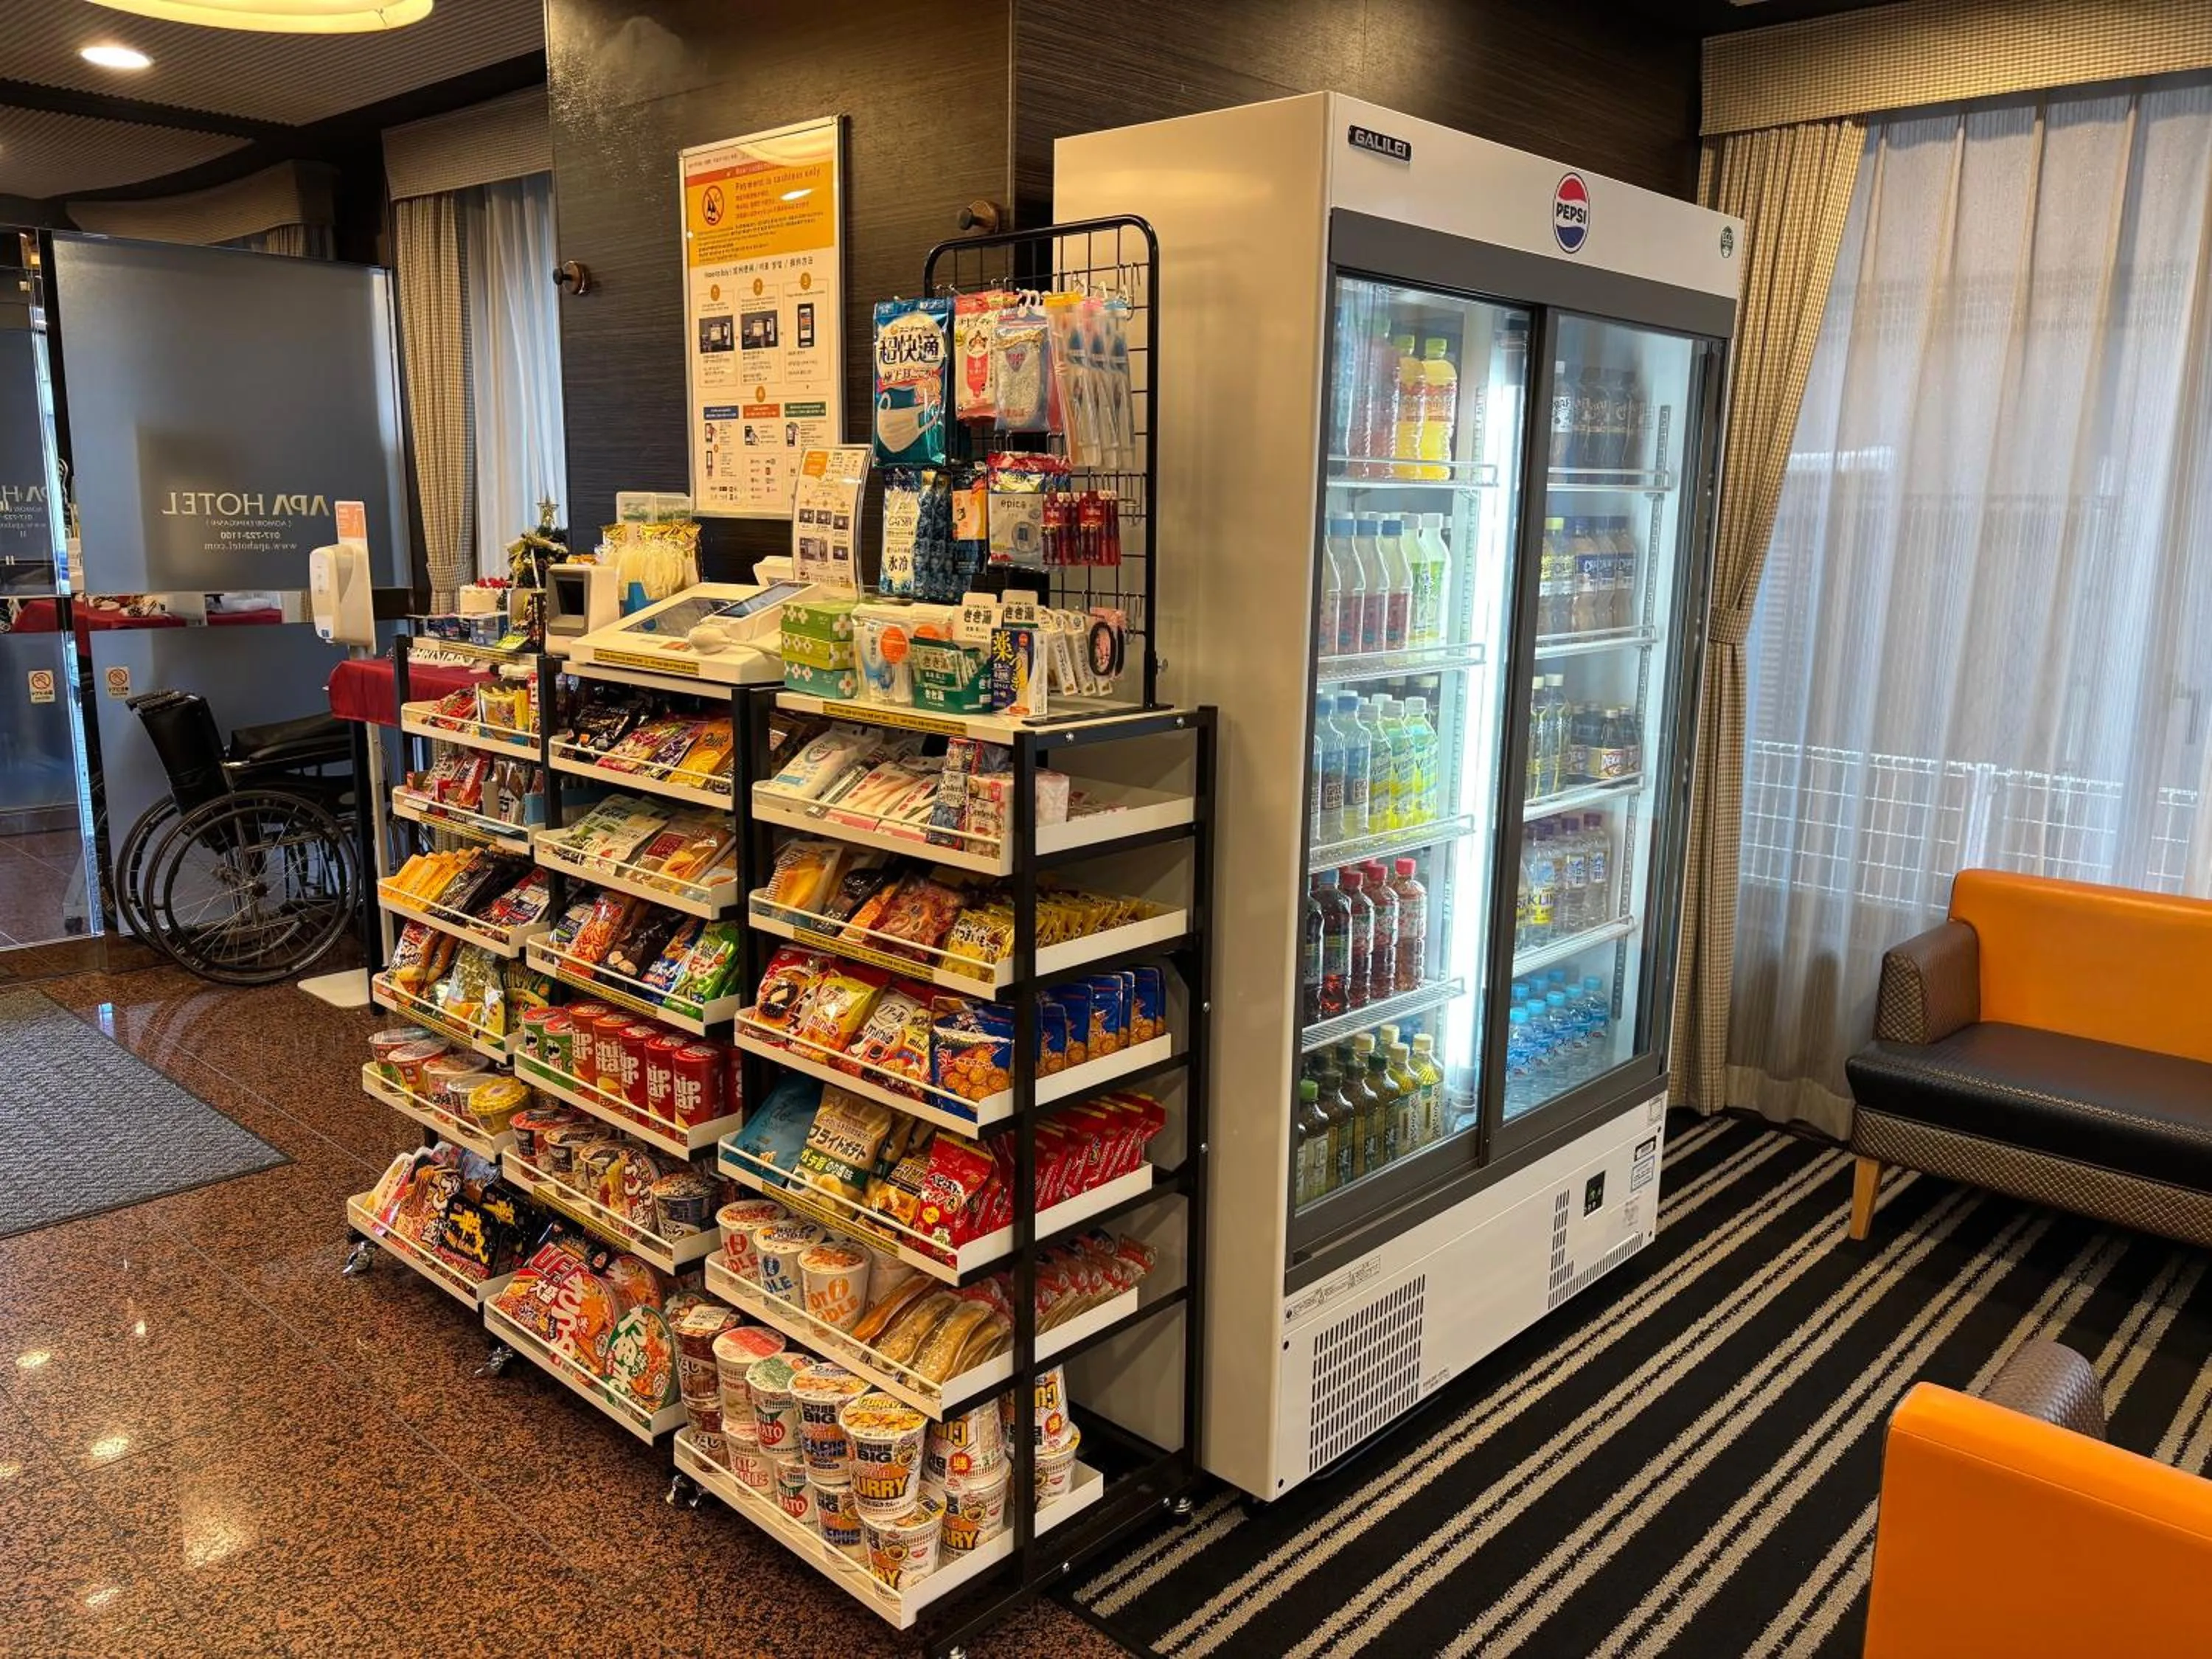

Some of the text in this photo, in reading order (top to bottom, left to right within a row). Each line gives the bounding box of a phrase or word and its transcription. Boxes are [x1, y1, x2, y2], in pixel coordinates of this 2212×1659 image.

[1354, 128, 1407, 157] GALILEI
[1556, 202, 1587, 224] PEPSI
[879, 333, 941, 365] 超快適
[596, 1040, 621, 1058] chi
[809, 1123, 866, 1161] フライドポテト
[529, 1279, 559, 1304] 大盛
[802, 1412, 837, 1425] BIG
[858, 1450, 892, 1463] BIG
